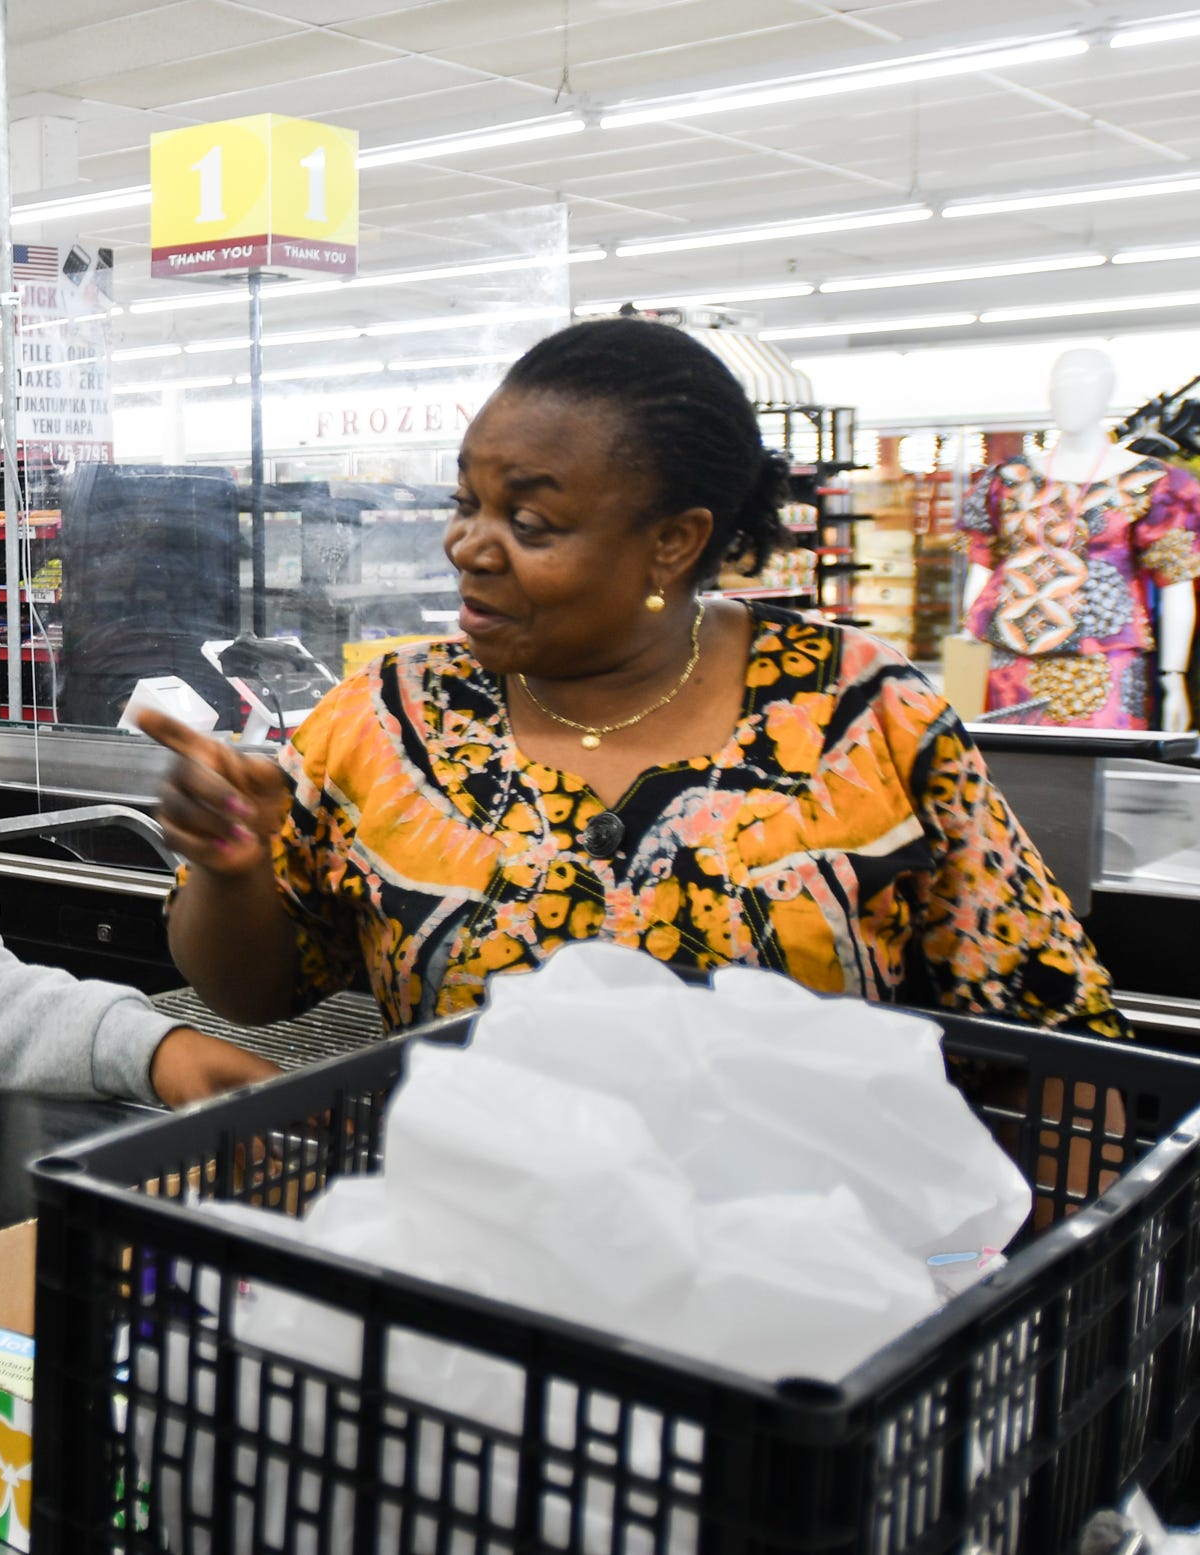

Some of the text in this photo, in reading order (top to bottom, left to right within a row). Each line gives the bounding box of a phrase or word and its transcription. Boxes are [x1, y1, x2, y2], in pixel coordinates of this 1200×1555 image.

[190, 144, 228, 224] 1
[300, 145, 328, 223] 1
[168, 244, 255, 267] THANK YOU
[283, 244, 347, 264] THANK YOU
[22, 343, 52, 362] FILE
[17, 368, 61, 388] TAXES
[33, 418, 93, 435] YENU HAPA
[316, 402, 474, 438] FROZEN
